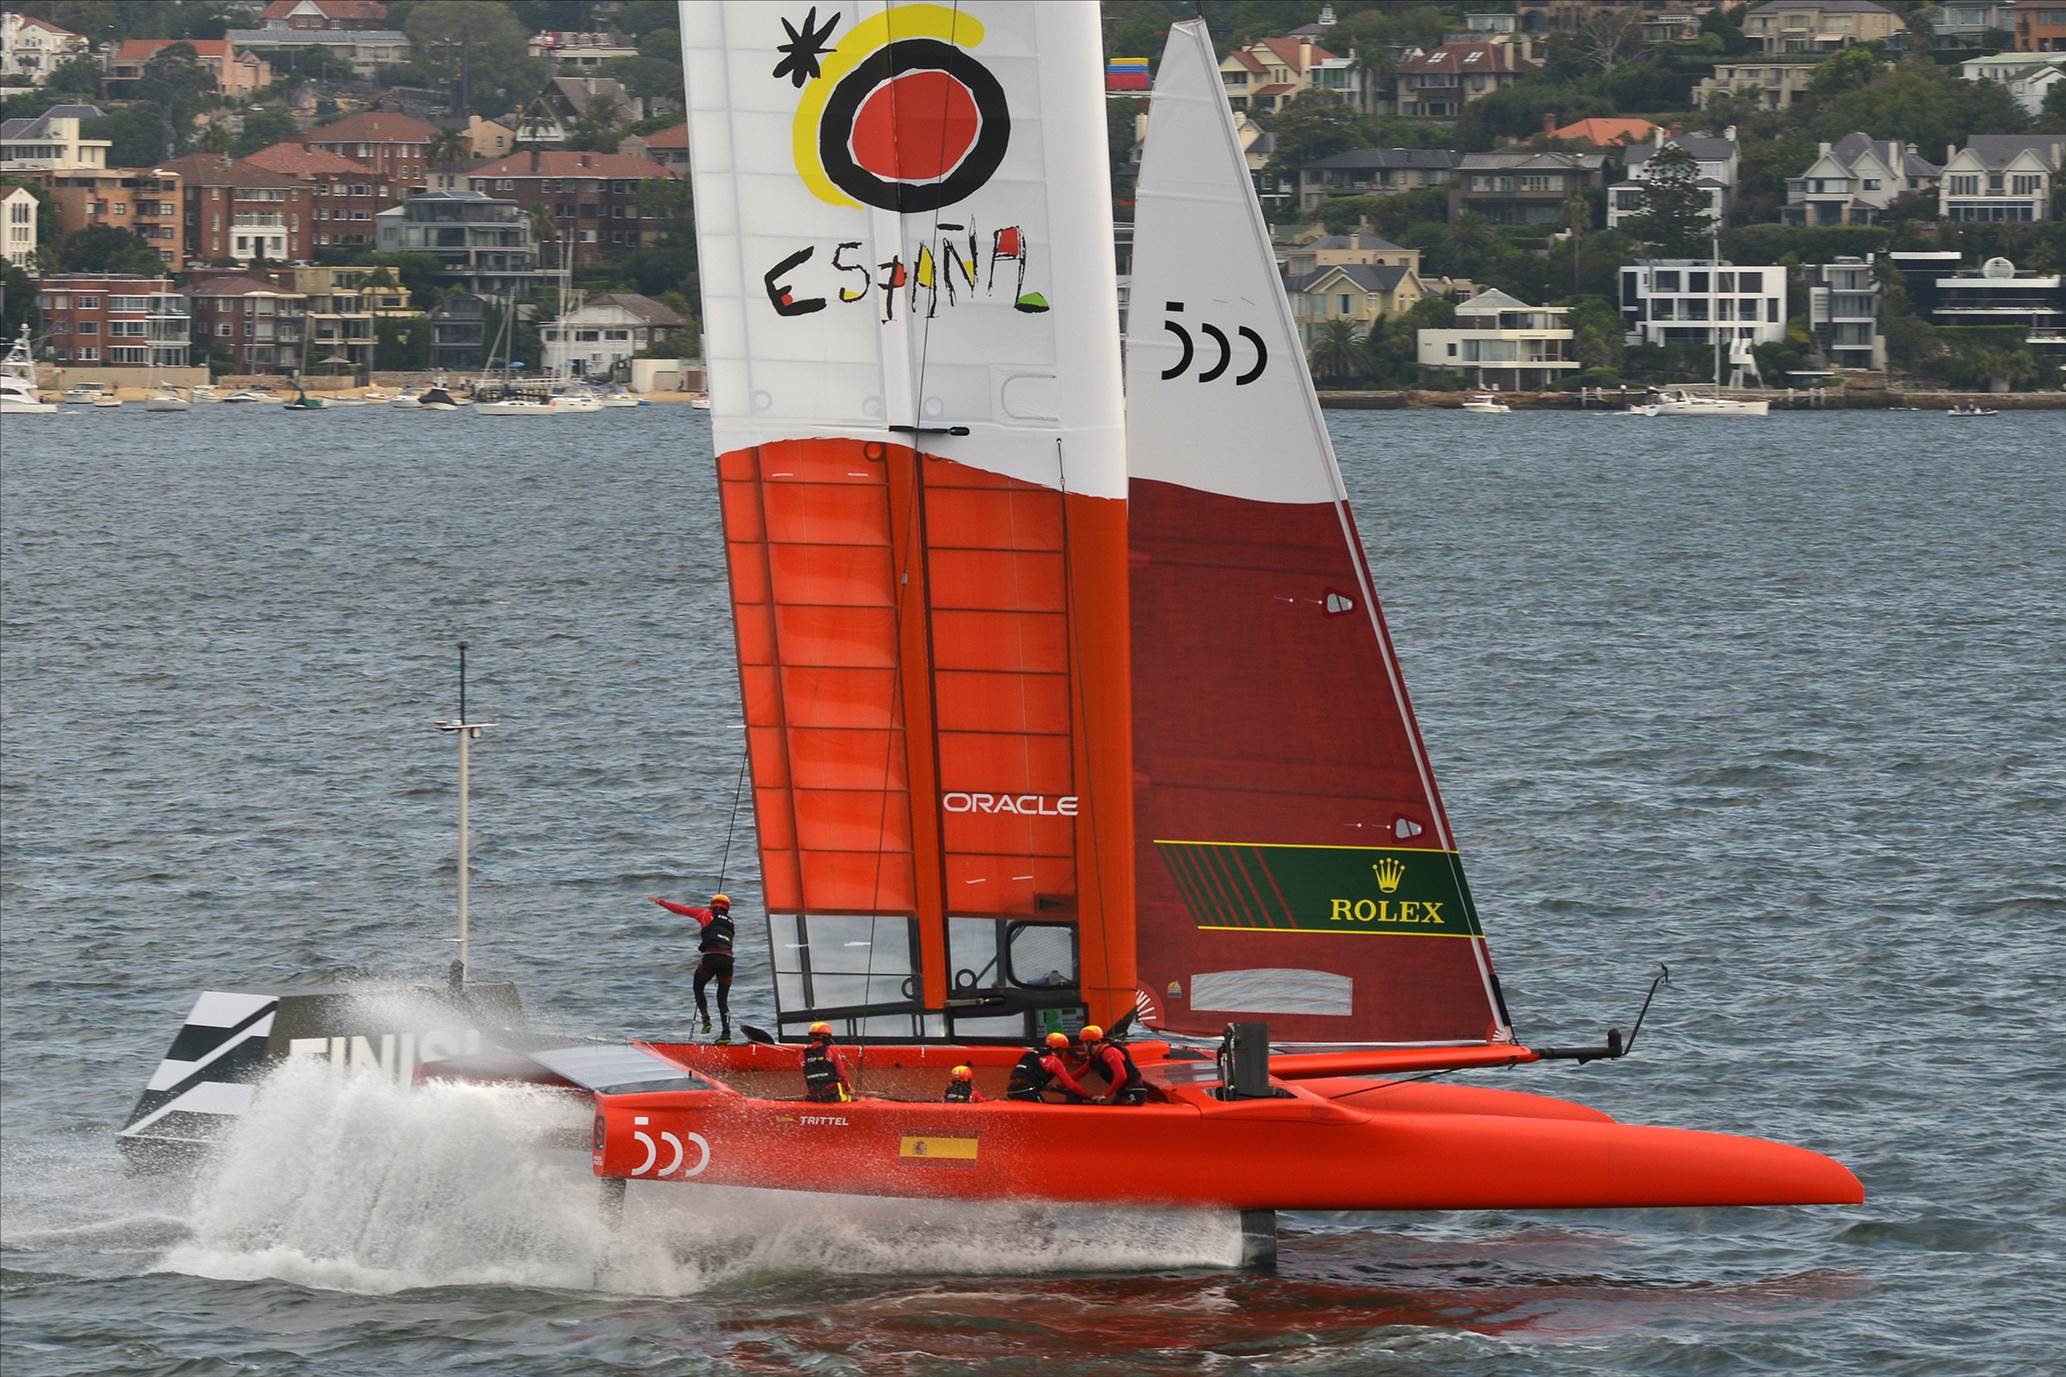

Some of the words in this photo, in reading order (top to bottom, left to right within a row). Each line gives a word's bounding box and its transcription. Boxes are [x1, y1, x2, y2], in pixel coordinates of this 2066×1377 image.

[943, 792, 1079, 816] ORACLE
[1330, 898, 1445, 923] ROLEX
[289, 1029, 481, 1089] INIS
[800, 1116, 849, 1126] TRITTEL
